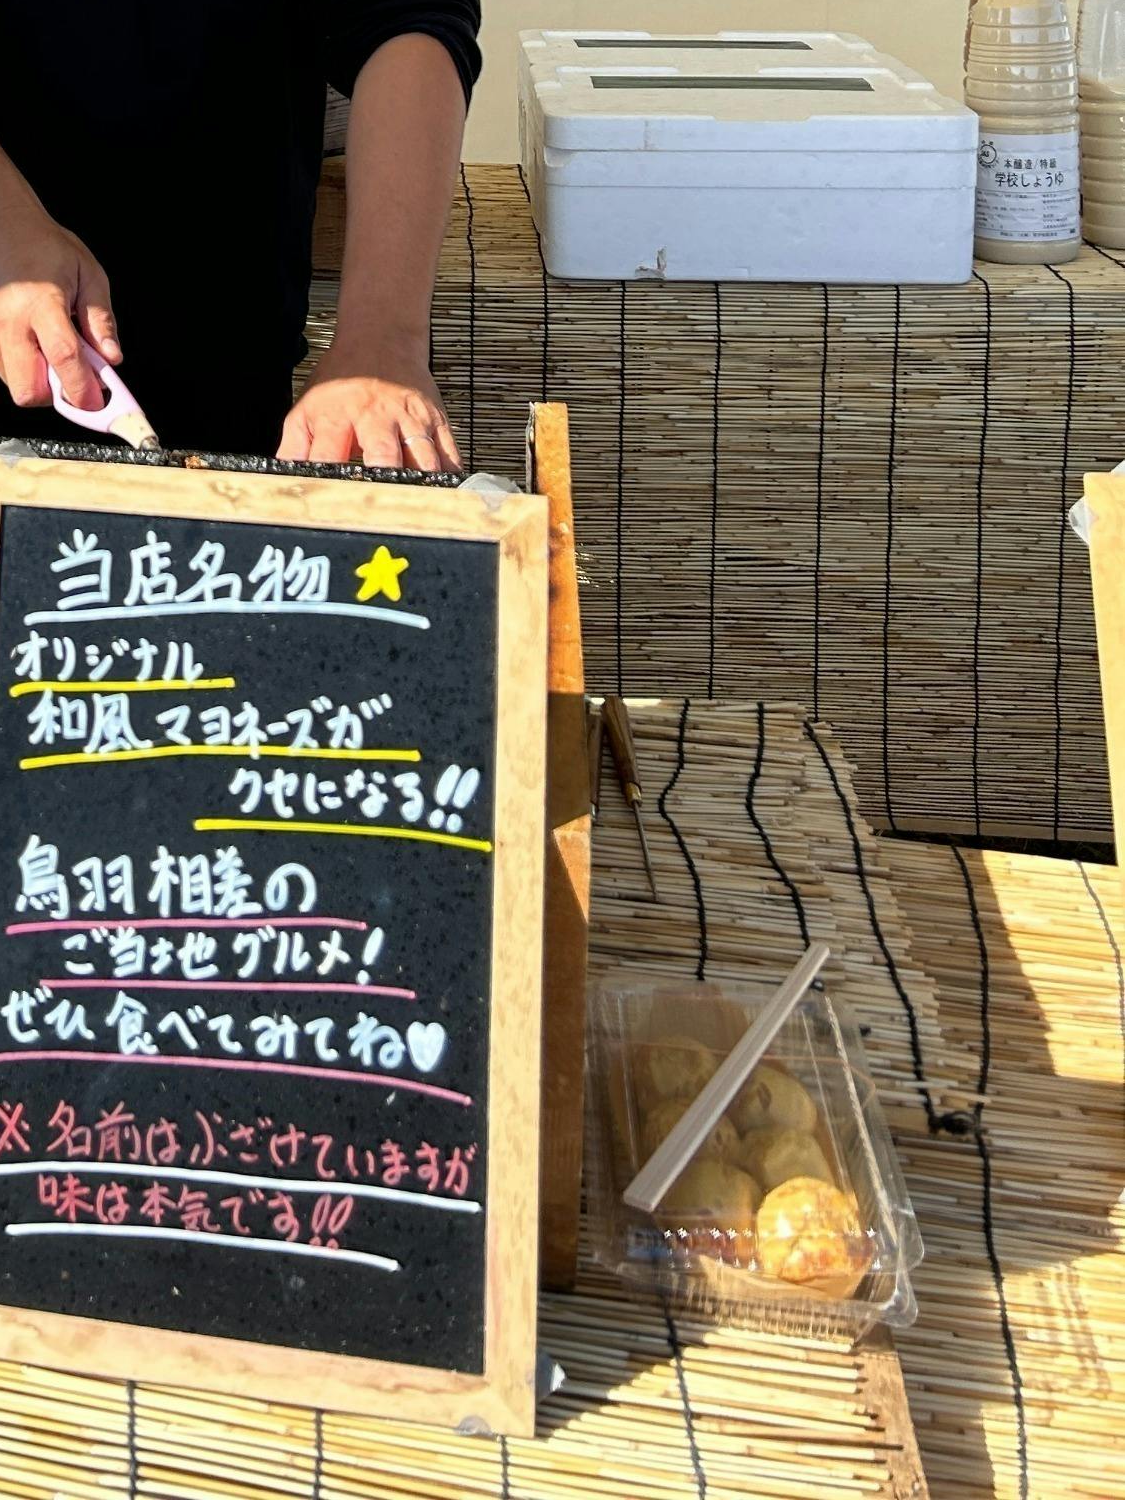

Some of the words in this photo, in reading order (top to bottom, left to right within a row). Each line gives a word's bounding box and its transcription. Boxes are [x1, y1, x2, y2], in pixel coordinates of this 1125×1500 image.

[994, 171, 1065, 188] 学校しょうゆ
[49, 528, 331, 610] 当店名物
[12, 630, 204, 682] オリジナル
[14, 834, 318, 919] 鳥羽相差の
